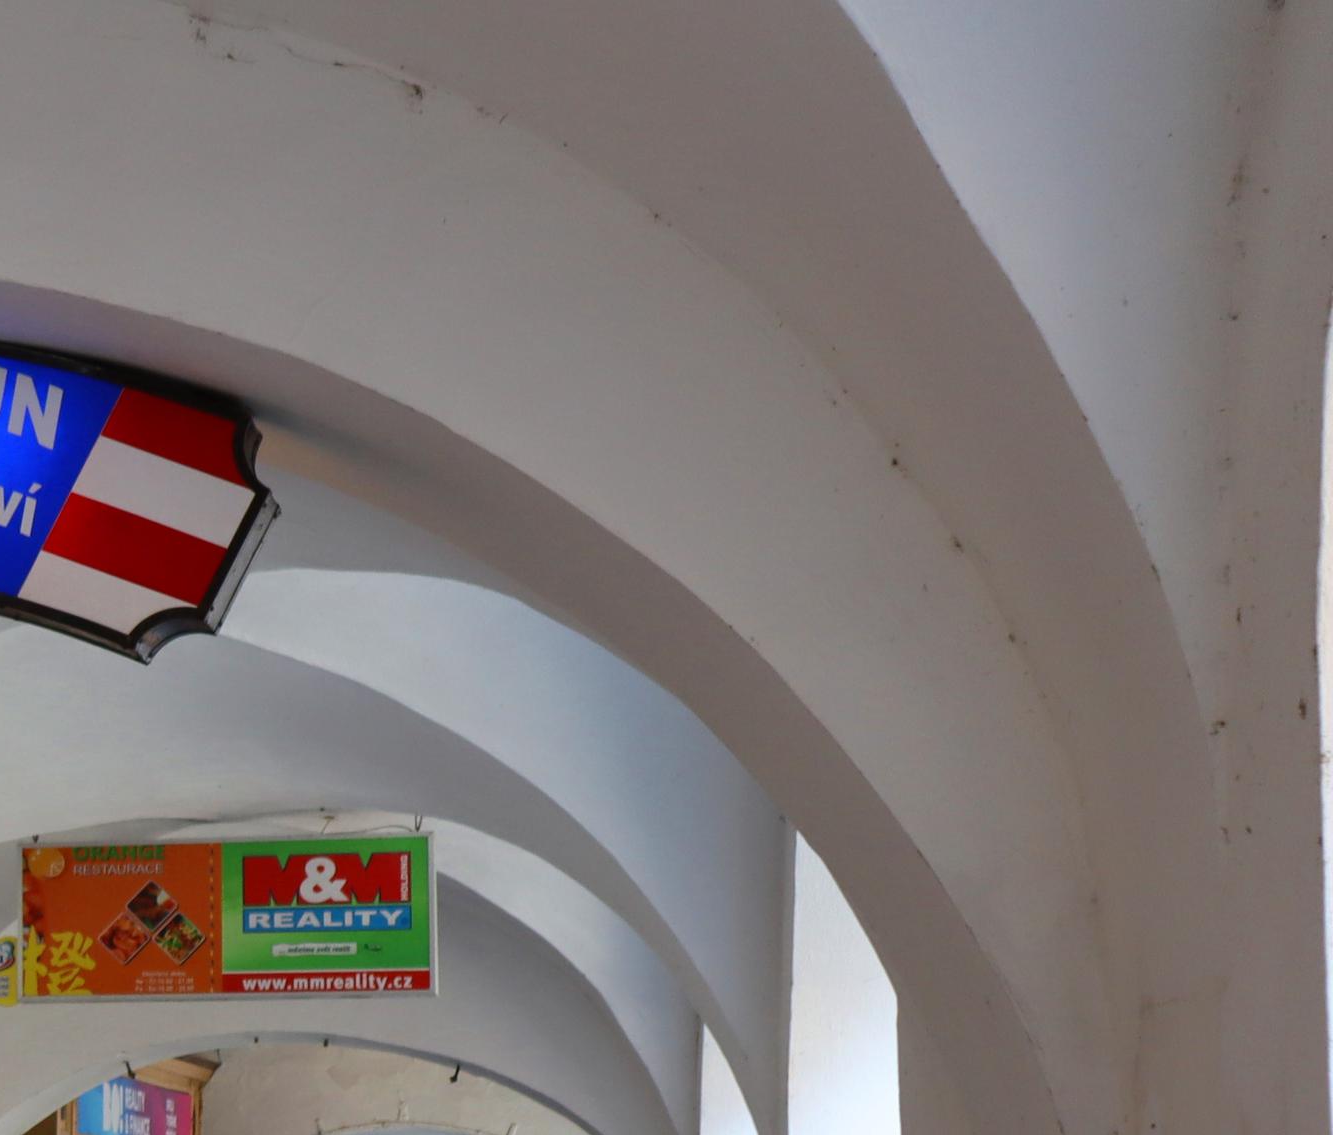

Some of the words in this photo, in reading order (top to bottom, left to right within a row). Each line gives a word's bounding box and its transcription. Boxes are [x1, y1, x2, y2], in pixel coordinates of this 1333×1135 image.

[73, 863, 164, 876] RESTAURACE
[243, 852, 411, 906] M&M
[248, 908, 404, 929] REALITY
[242, 973, 412, 991] www.mmreality.cz
